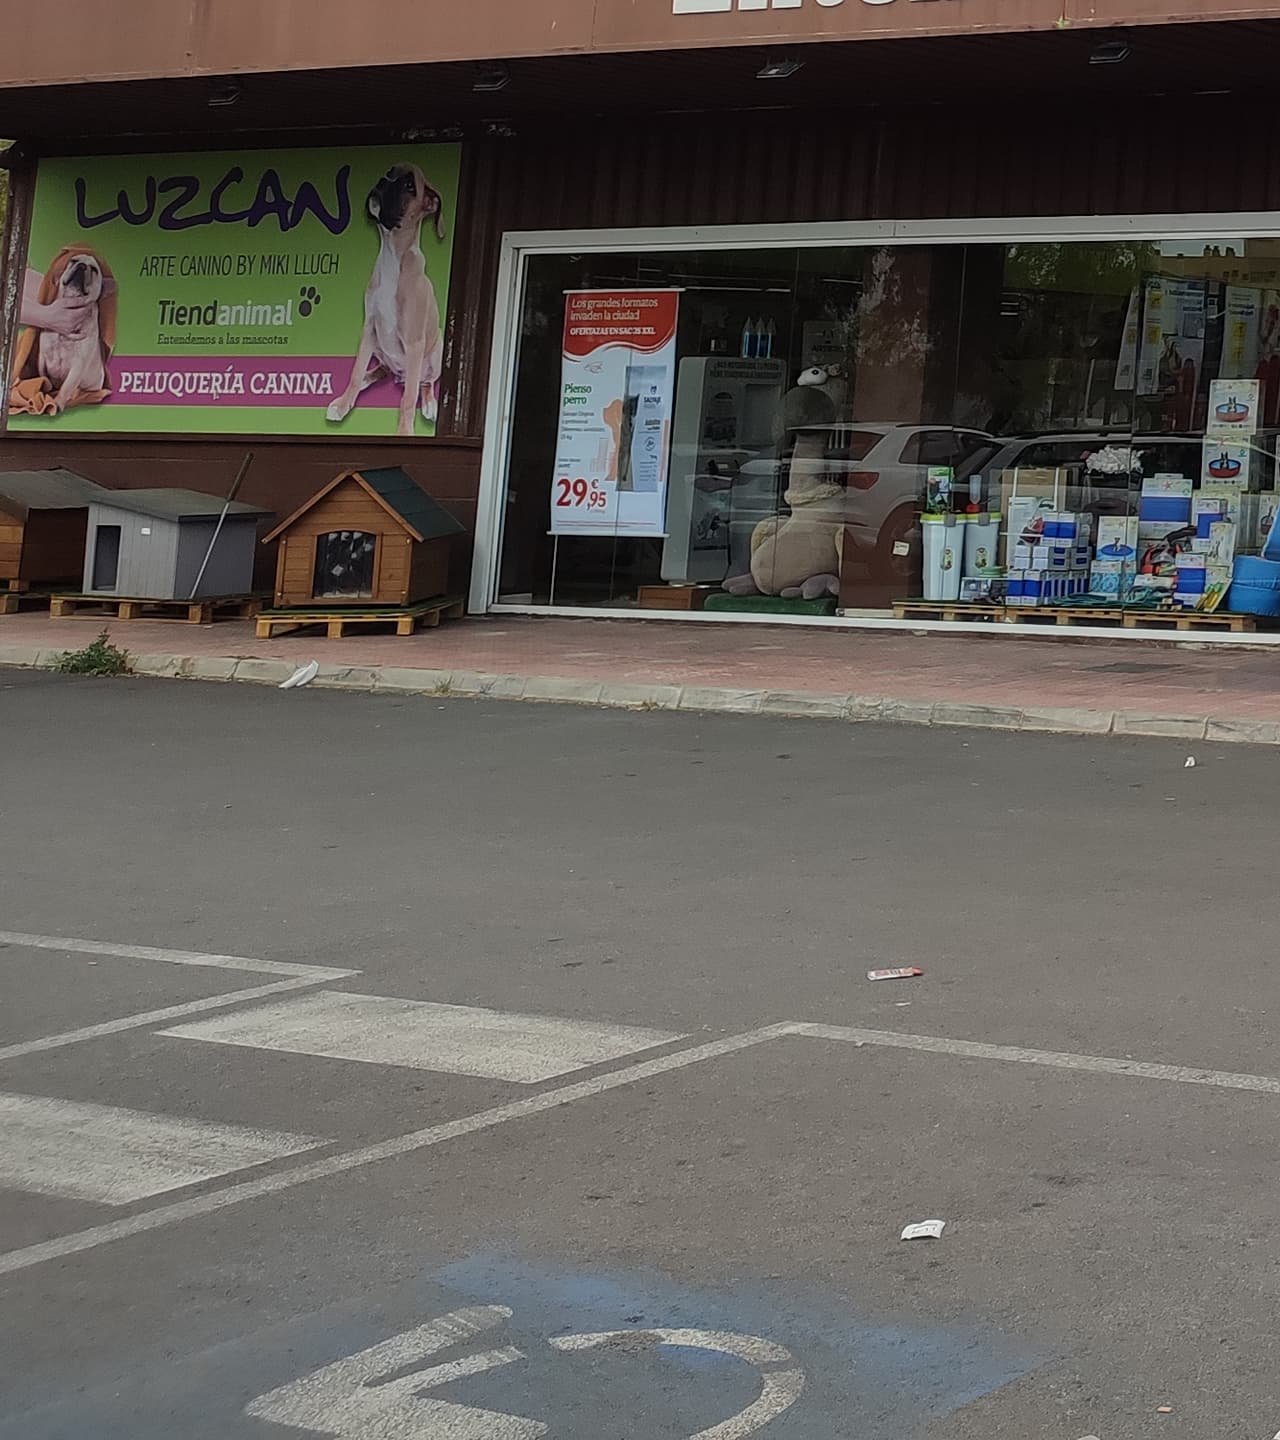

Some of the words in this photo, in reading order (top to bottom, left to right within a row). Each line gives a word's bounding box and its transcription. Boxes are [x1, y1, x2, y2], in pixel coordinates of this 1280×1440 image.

[74, 164, 351, 235] LUZCAN
[139, 255, 176, 277] ARTE
[180, 255, 232, 277] CANINO
[236, 254, 256, 276] BY
[259, 254, 292, 276] MIKI
[294, 253, 340, 275] LLUCH
[158, 299, 293, 326] Tiendanimal
[157, 333, 216, 345] Entendemos
[218, 336, 224, 345] a
[226, 332, 240, 345] las
[242, 334, 288, 345] mascotas
[119, 364, 245, 397] PELUQUERÍA
[250, 372, 333, 395] CANINA
[564, 383, 592, 394] Pienso
[563, 397, 587, 407] perro
